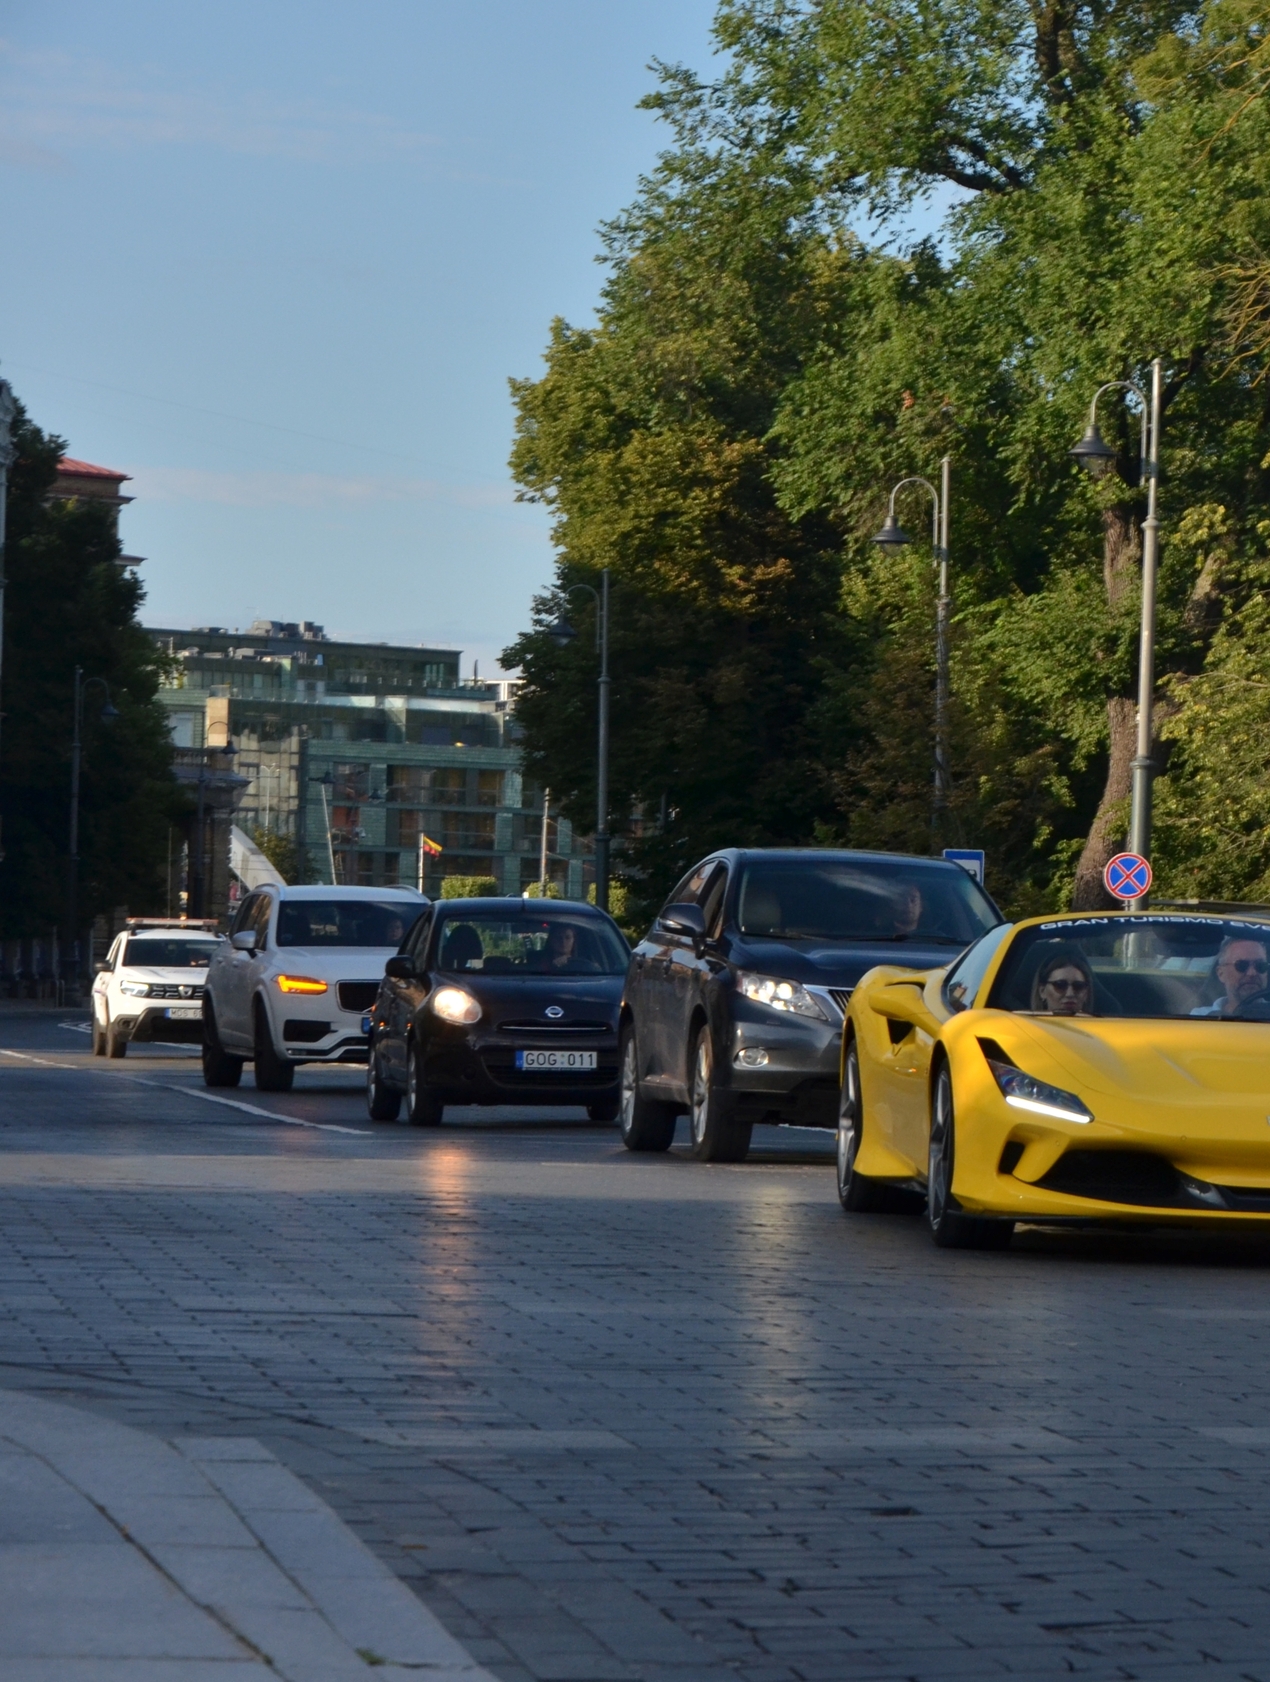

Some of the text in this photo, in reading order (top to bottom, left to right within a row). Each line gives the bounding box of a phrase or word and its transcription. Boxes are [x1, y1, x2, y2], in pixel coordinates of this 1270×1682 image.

[1040, 918, 1108, 930] GRAN
[1114, 916, 1223, 925] TURISMO
[525, 1052, 593, 1066] GOG 011
